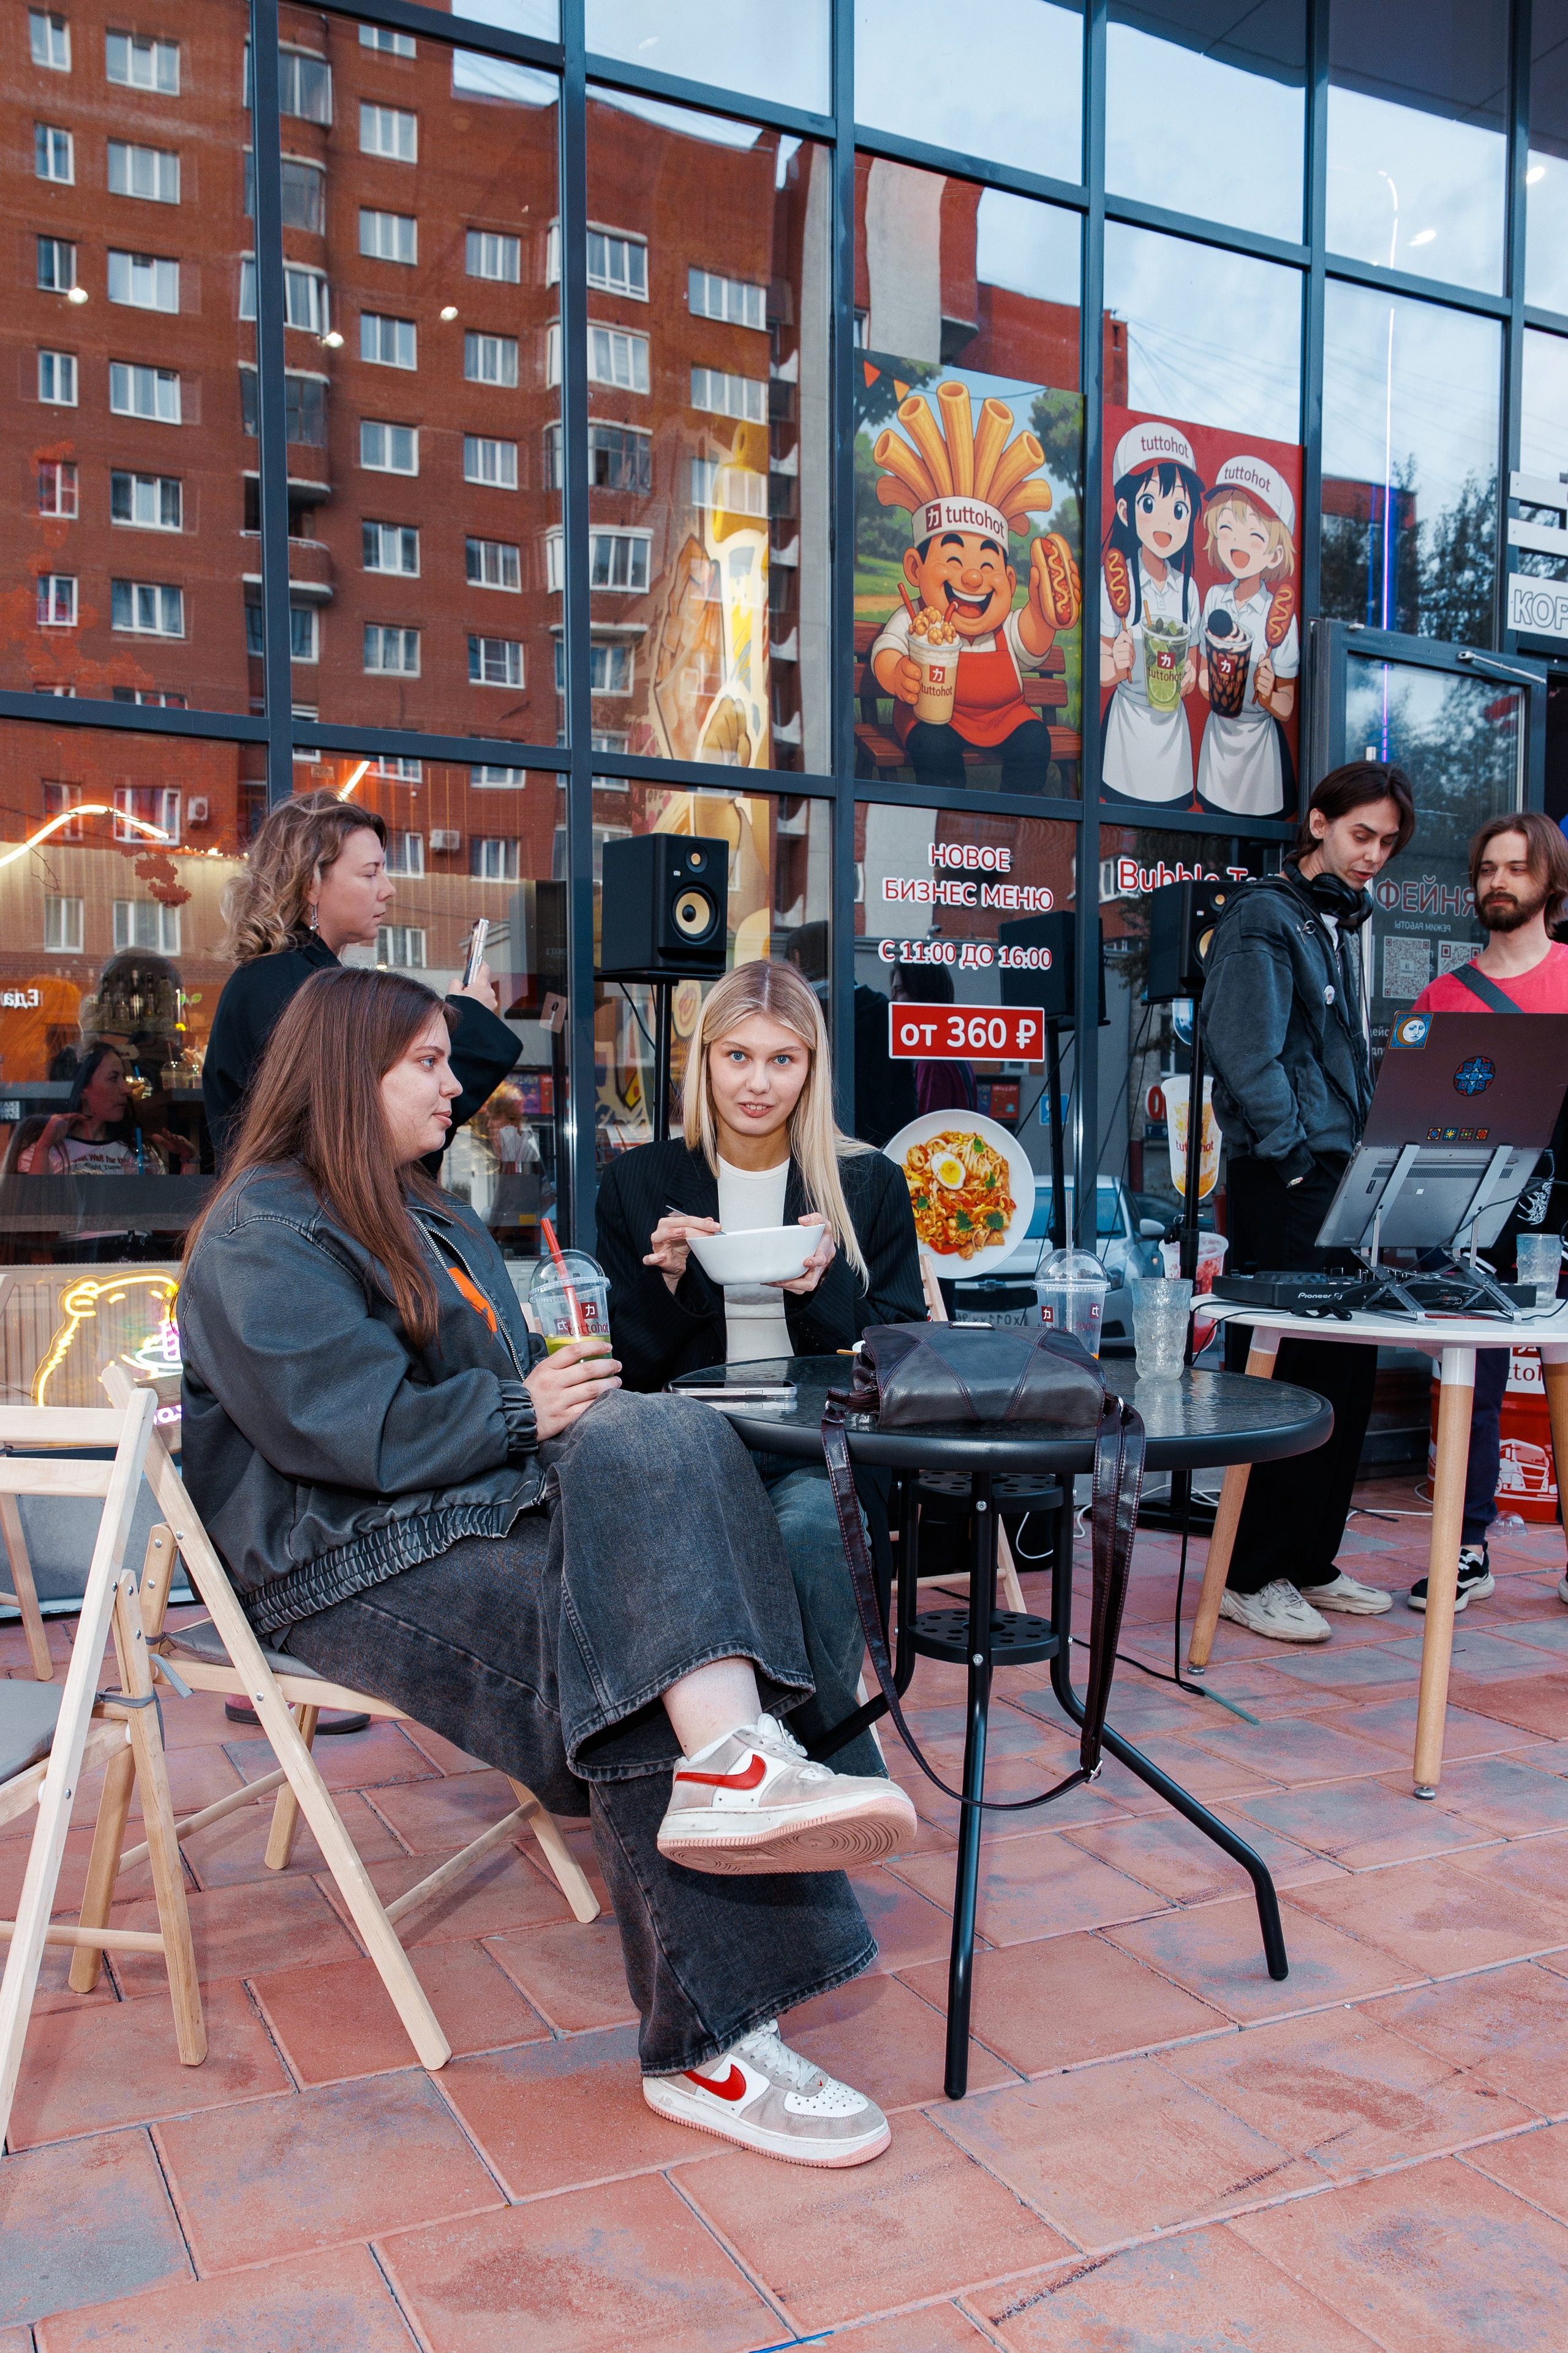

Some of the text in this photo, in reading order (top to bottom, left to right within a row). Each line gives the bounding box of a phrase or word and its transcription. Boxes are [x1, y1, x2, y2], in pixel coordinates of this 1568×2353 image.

[1141, 436, 1189, 459] tuttohot
[1224, 466, 1271, 492] tuttohot
[946, 506, 1005, 538] tuttohot
[1148, 666, 1182, 682] tuttohot
[921, 682, 952, 697] tuttohot
[929, 843, 1010, 872] НОВОЕ
[883, 877, 1053, 911] БИЗНЕС МЕНЮ
[880, 940, 1052, 969] С 11:00 ДО 16:00
[900, 1023, 938, 1046] от
[946, 1016, 1007, 1049] 360
